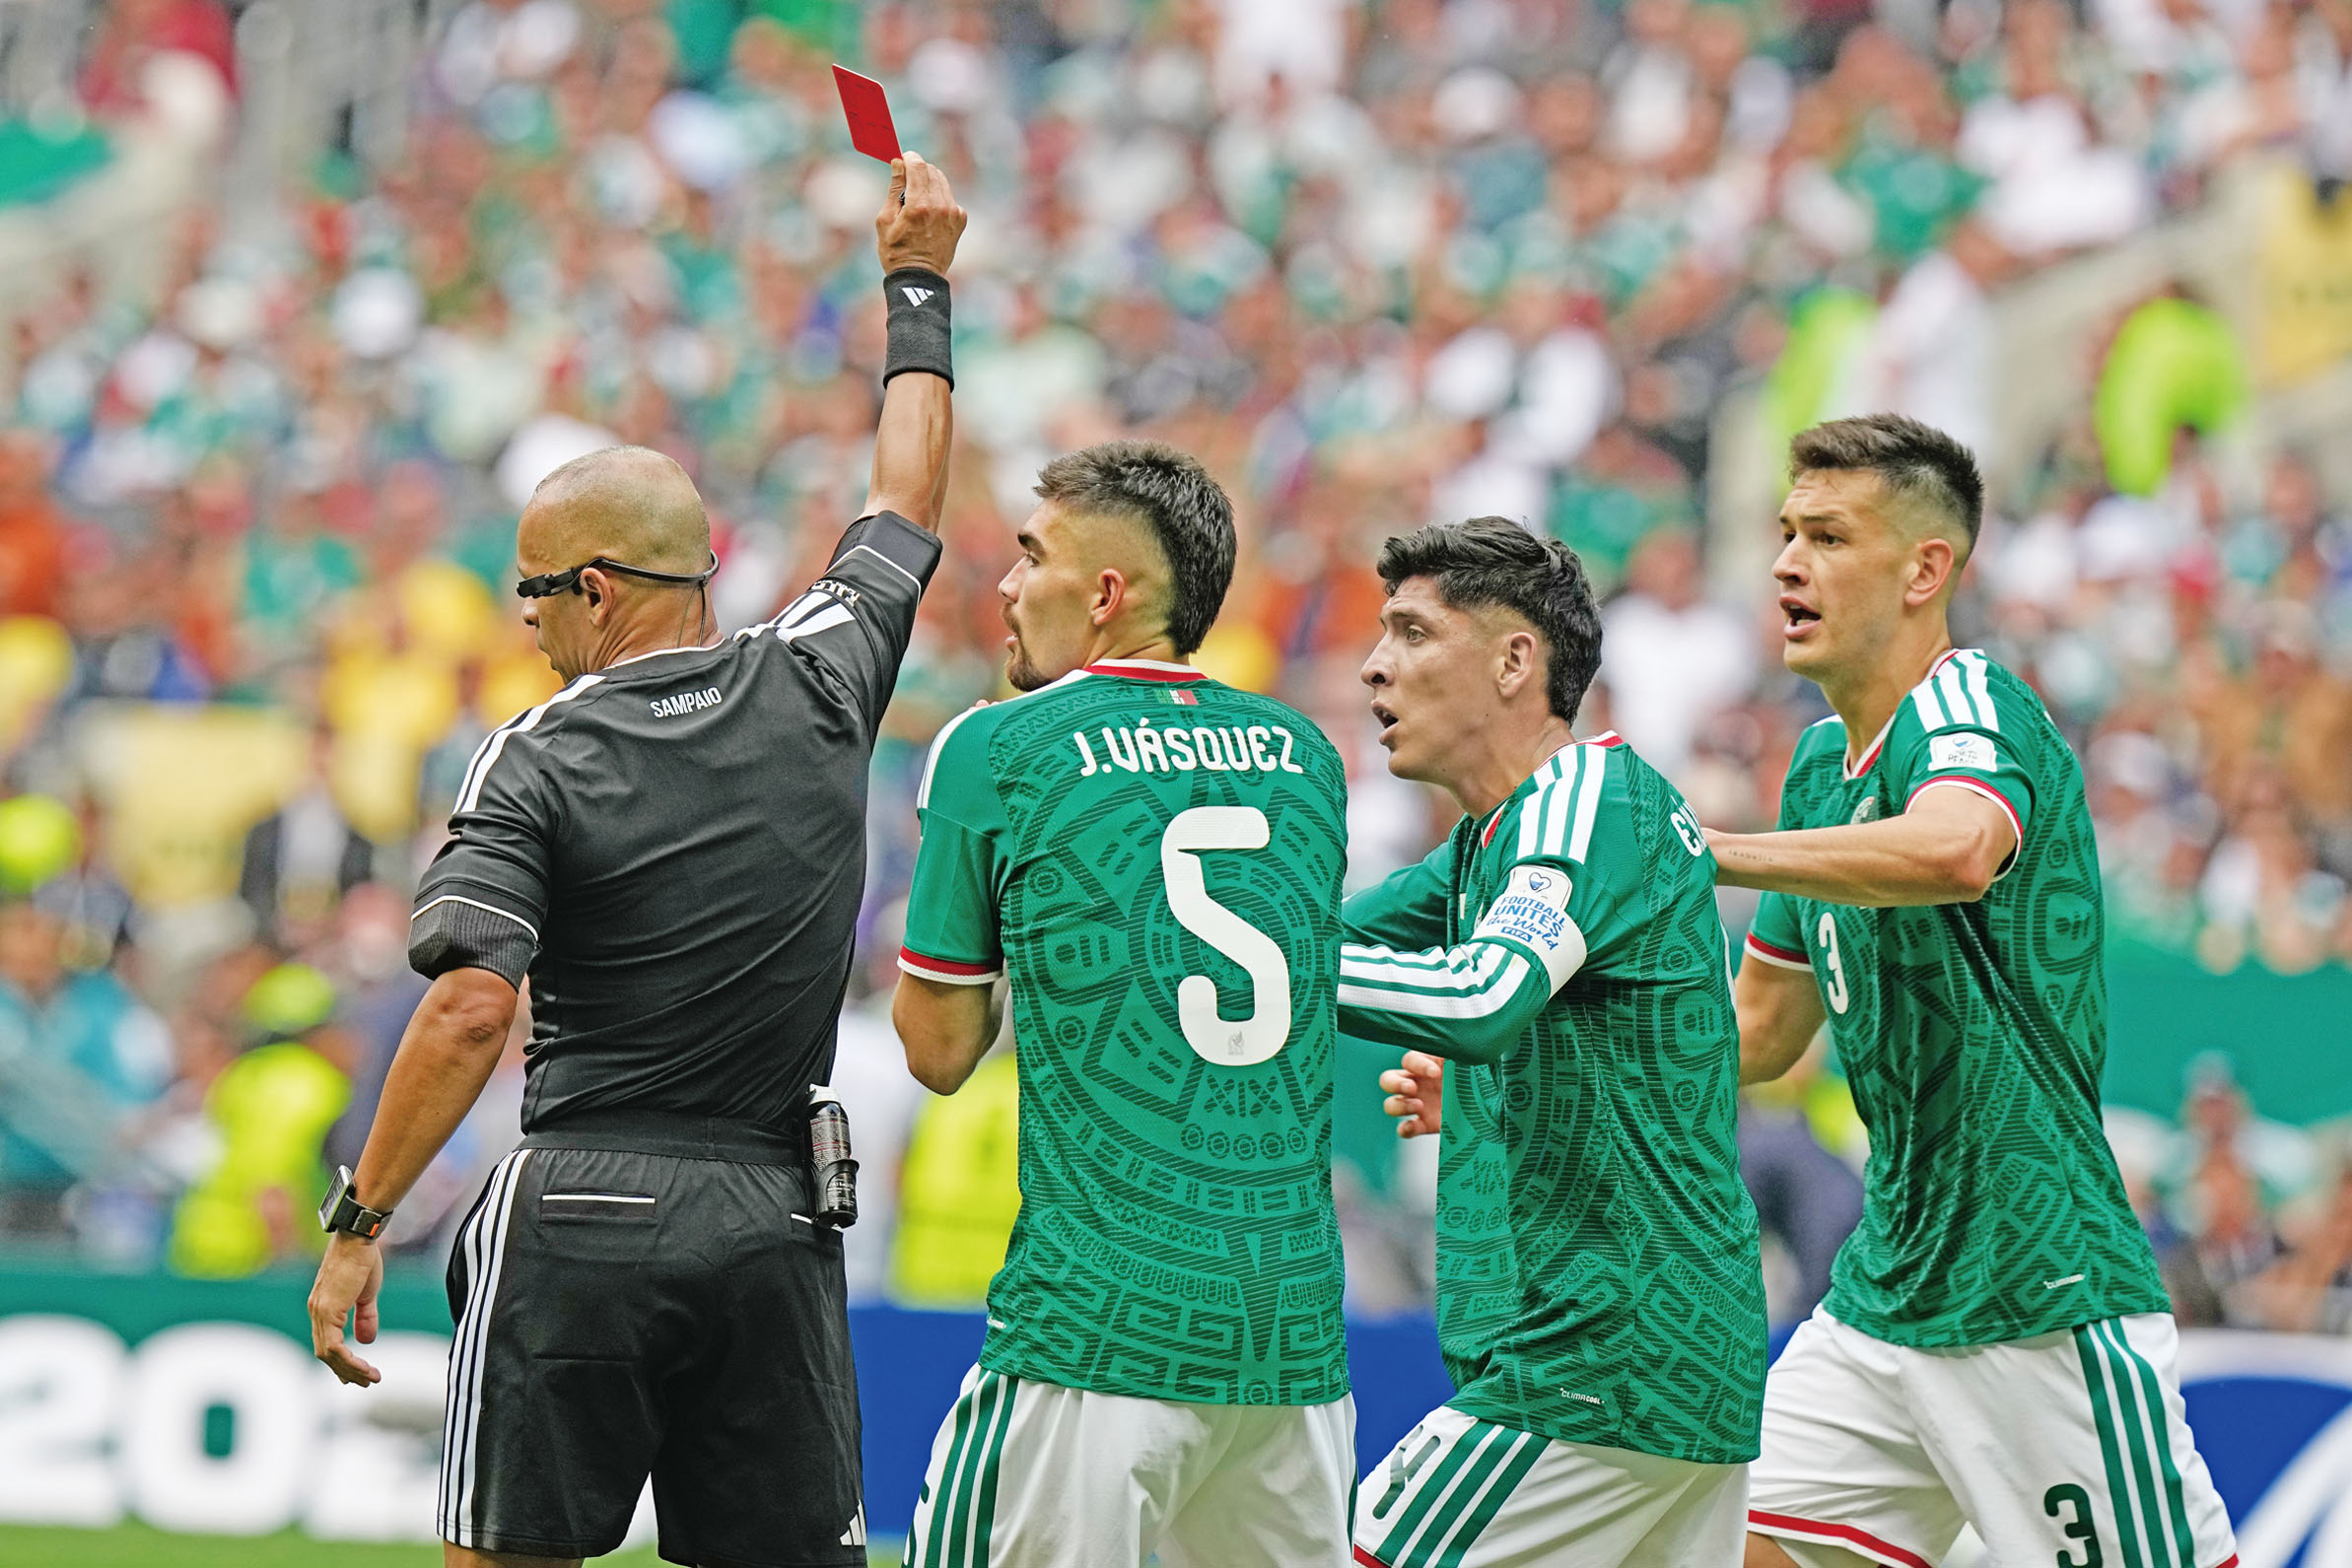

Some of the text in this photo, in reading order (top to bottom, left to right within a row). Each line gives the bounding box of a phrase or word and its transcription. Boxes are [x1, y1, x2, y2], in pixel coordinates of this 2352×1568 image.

[650, 687, 723, 717] SAMPAIO
[1073, 716, 1303, 777] J.VÁSQUEZ
[1494, 905, 1562, 937] UNITES
[1500, 896, 1565, 927] FOOTBALL
[1513, 918, 1558, 950] World
[1160, 806, 1291, 1066] 5
[1818, 912, 1849, 1014] 3
[2043, 1482, 2104, 1568] 3
